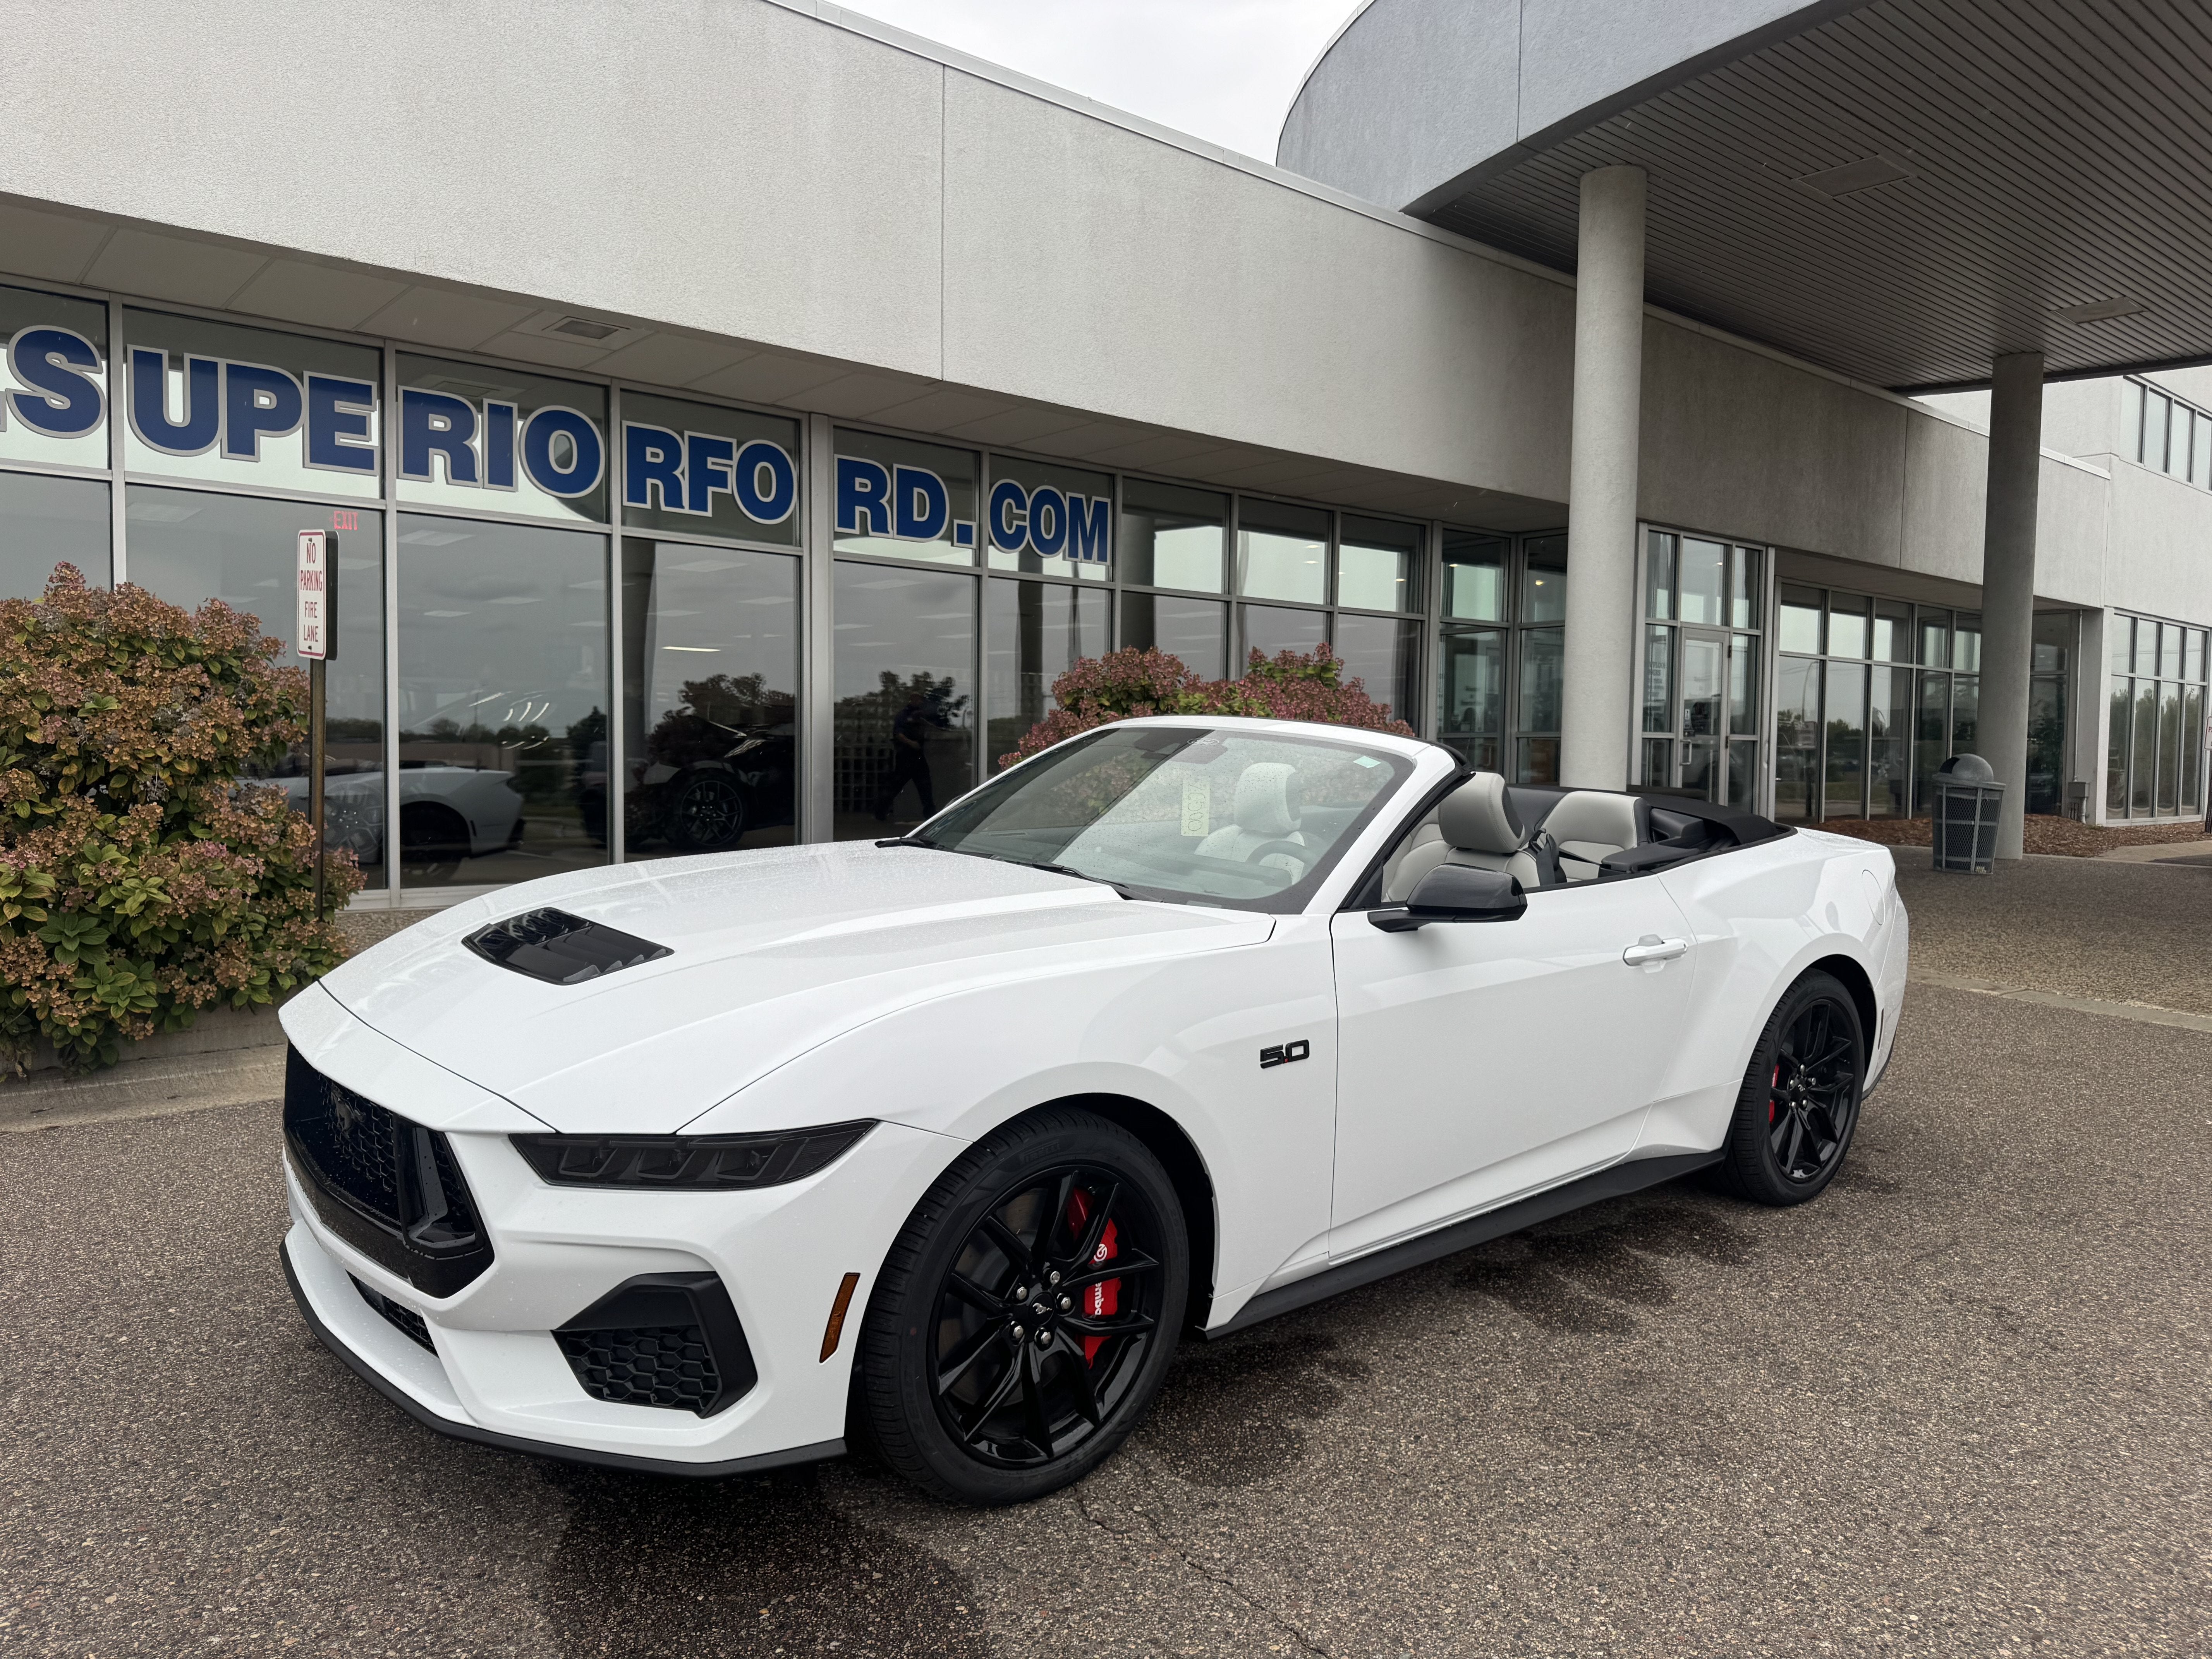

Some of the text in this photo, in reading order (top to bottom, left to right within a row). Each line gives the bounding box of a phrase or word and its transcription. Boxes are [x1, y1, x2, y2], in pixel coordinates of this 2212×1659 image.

[334, 511, 358, 530] EXIT
[307, 543, 316, 563] NO
[301, 570, 322, 591] PARKING
[305, 601, 317, 618] FIRE
[304, 624, 318, 642] LANE
[1260, 1039, 1310, 1069] 5.0
[1094, 1282, 1104, 1315] embo
